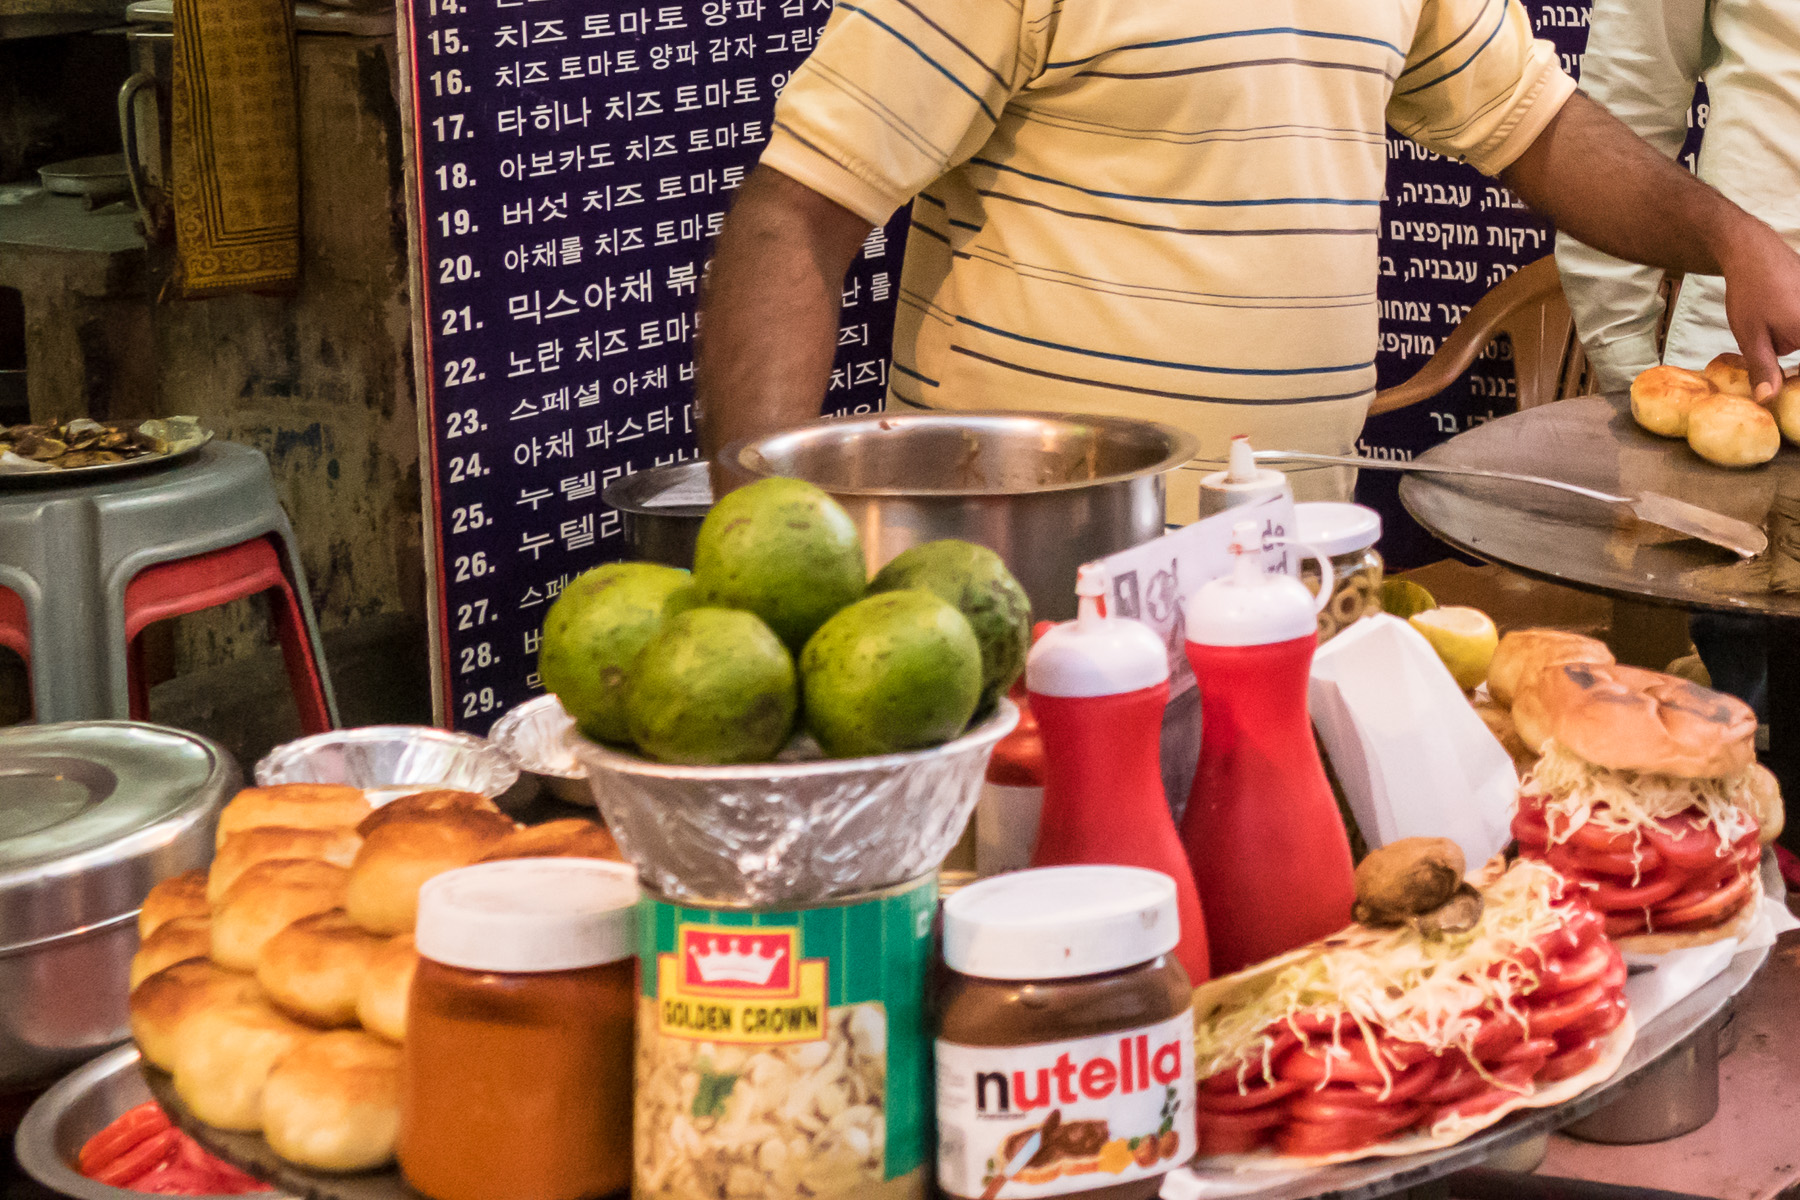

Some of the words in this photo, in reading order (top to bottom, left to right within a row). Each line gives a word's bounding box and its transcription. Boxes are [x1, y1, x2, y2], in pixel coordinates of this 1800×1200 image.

[436, 163, 476, 190] 18.
[500, 144, 614, 180] 아보카도
[626, 135, 678, 160] 치즈
[688, 121, 765, 152] 토마토
[1391, 221, 1478, 250] מוקפצים
[1487, 227, 1545, 254] ירקות
[1405, 258, 1477, 283] עגבניה,
[442, 306, 483, 335] 21.
[509, 269, 651, 324] 믹스야채
[463, 688, 502, 717] 29.
[661, 1000, 732, 1031] GOLDEN
[741, 1004, 819, 1034] CROWN
[974, 1033, 1183, 1114] nutella
